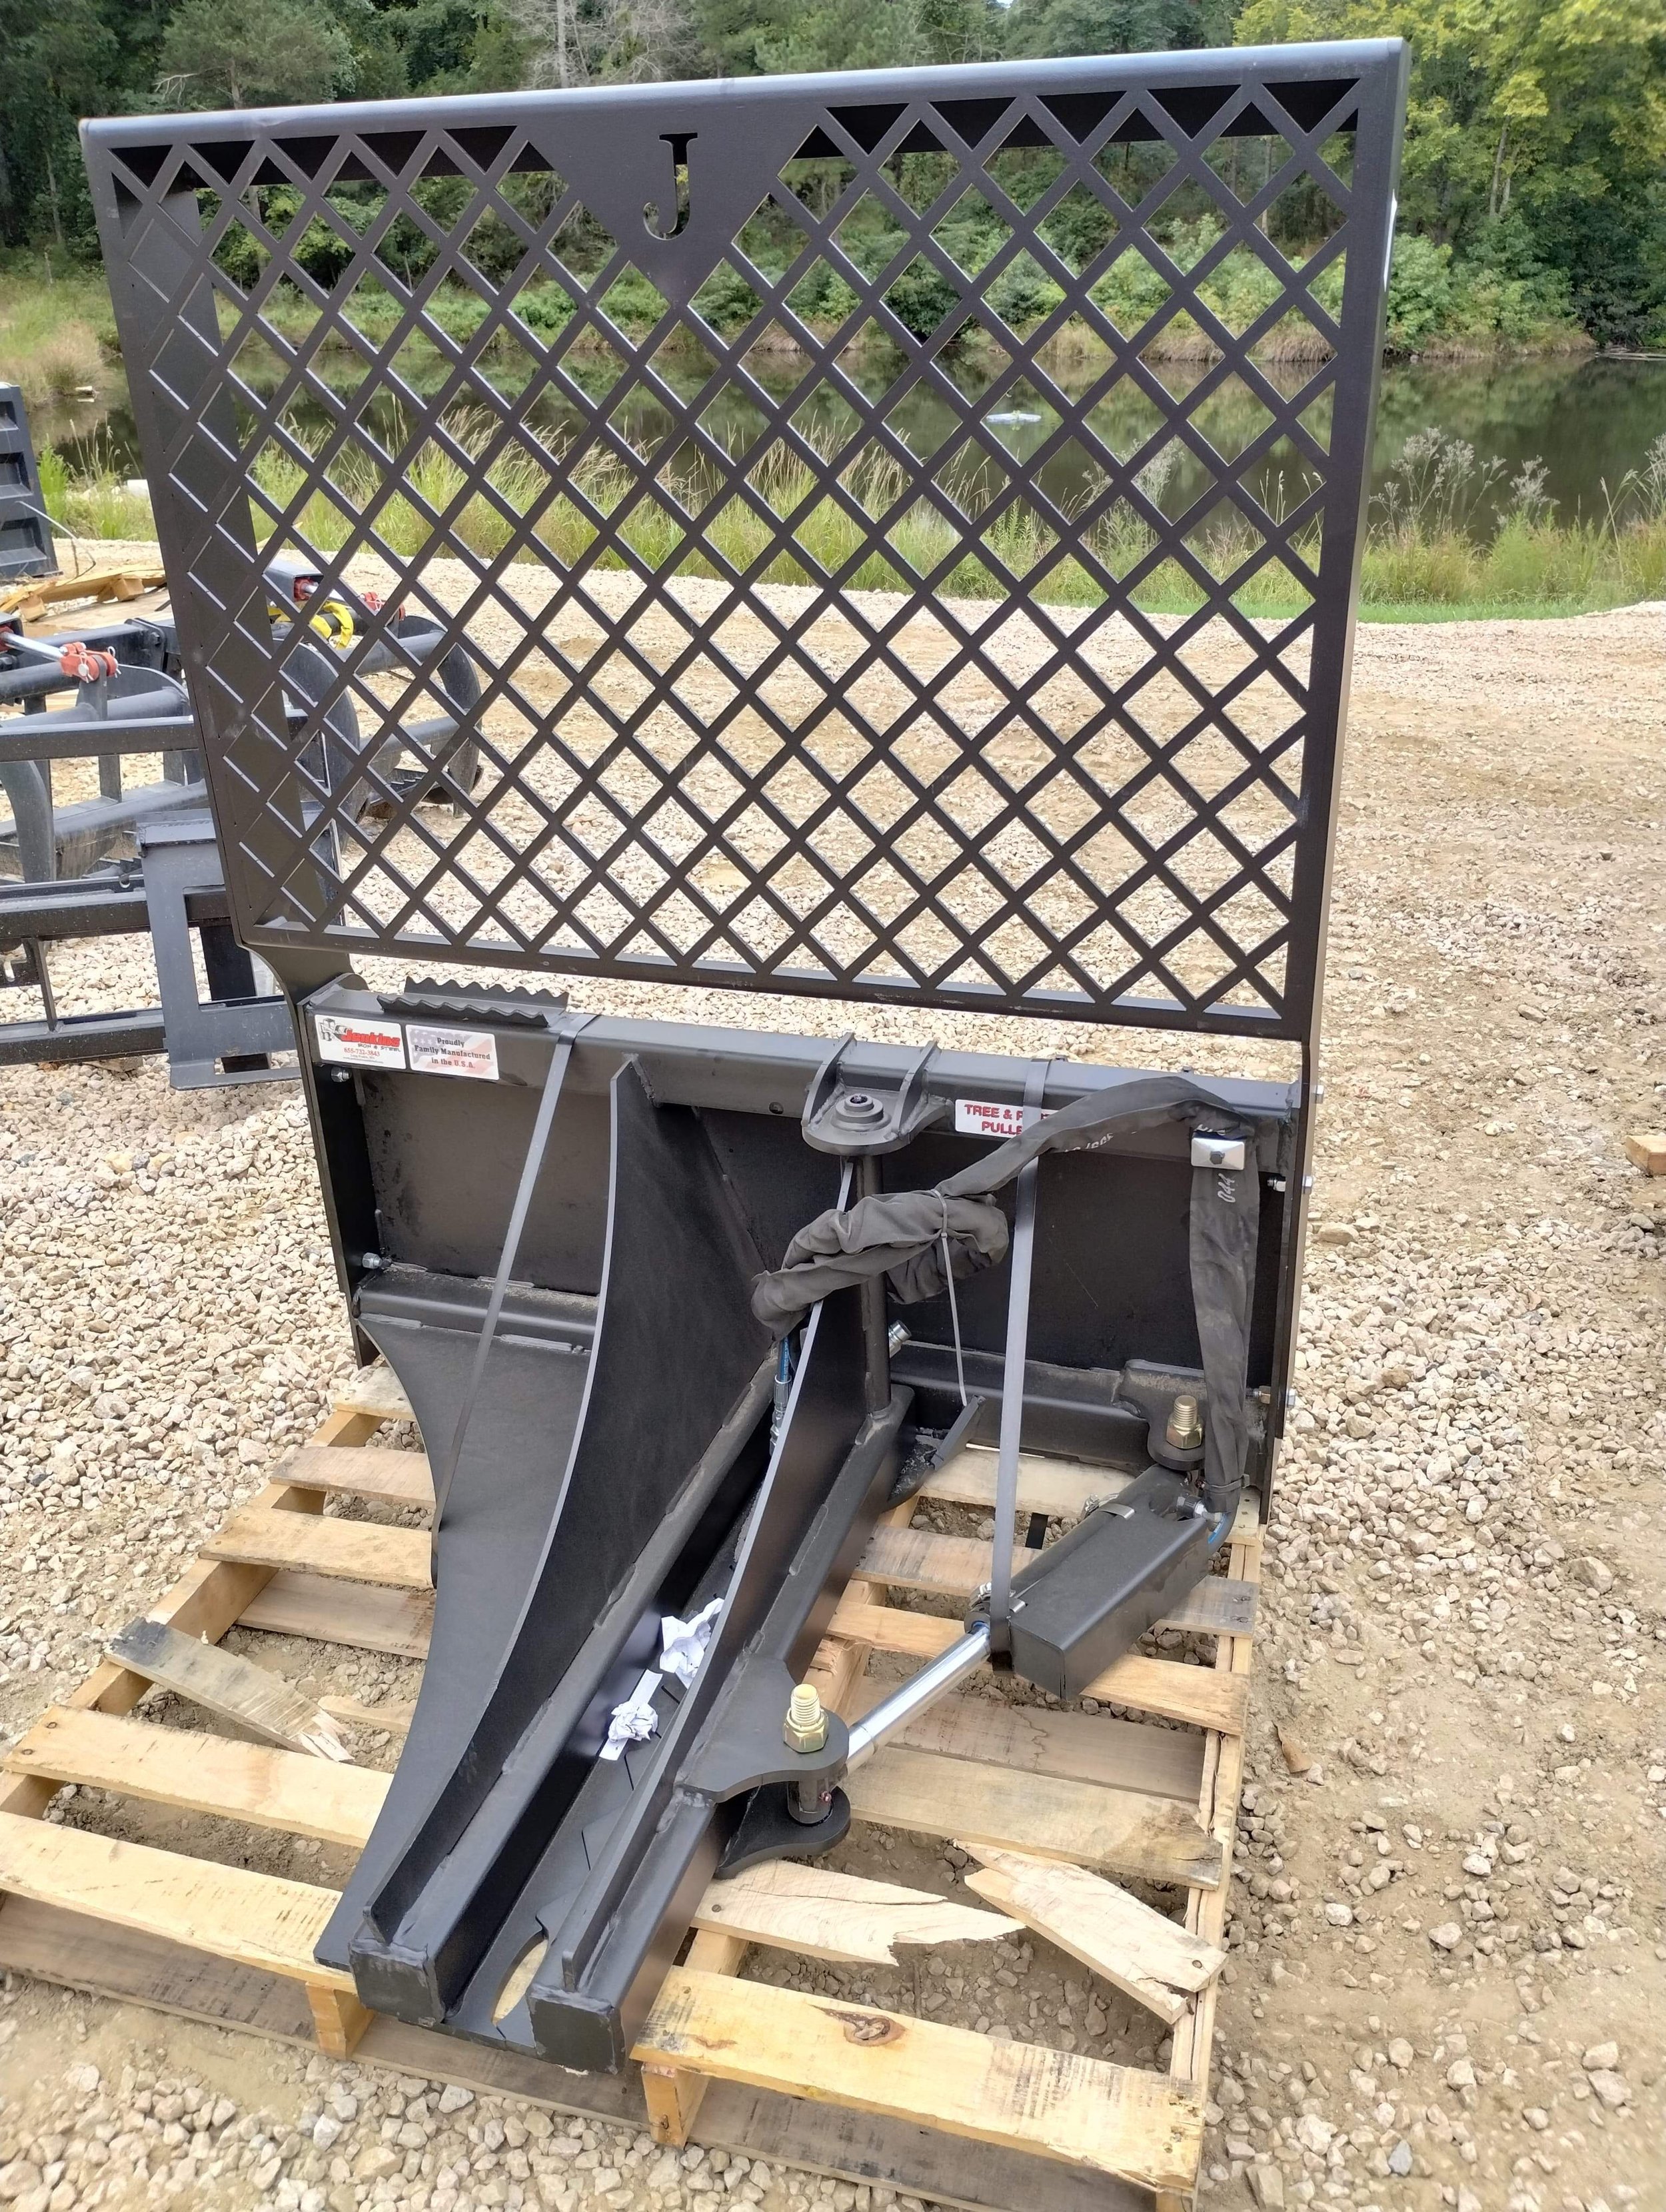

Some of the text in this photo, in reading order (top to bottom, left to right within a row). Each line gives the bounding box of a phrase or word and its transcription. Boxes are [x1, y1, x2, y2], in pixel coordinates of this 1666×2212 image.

[643, 133, 698, 241] J
[341, 1028, 400, 1047] Jenkins
[436, 1037, 464, 1048] Proudly
[415, 1045, 490, 1060] Family Manufactured
[964, 1104, 1000, 1118] TREE
[1003, 1109, 1012, 1120] &
[982, 1121, 1023, 1135] PULLE
